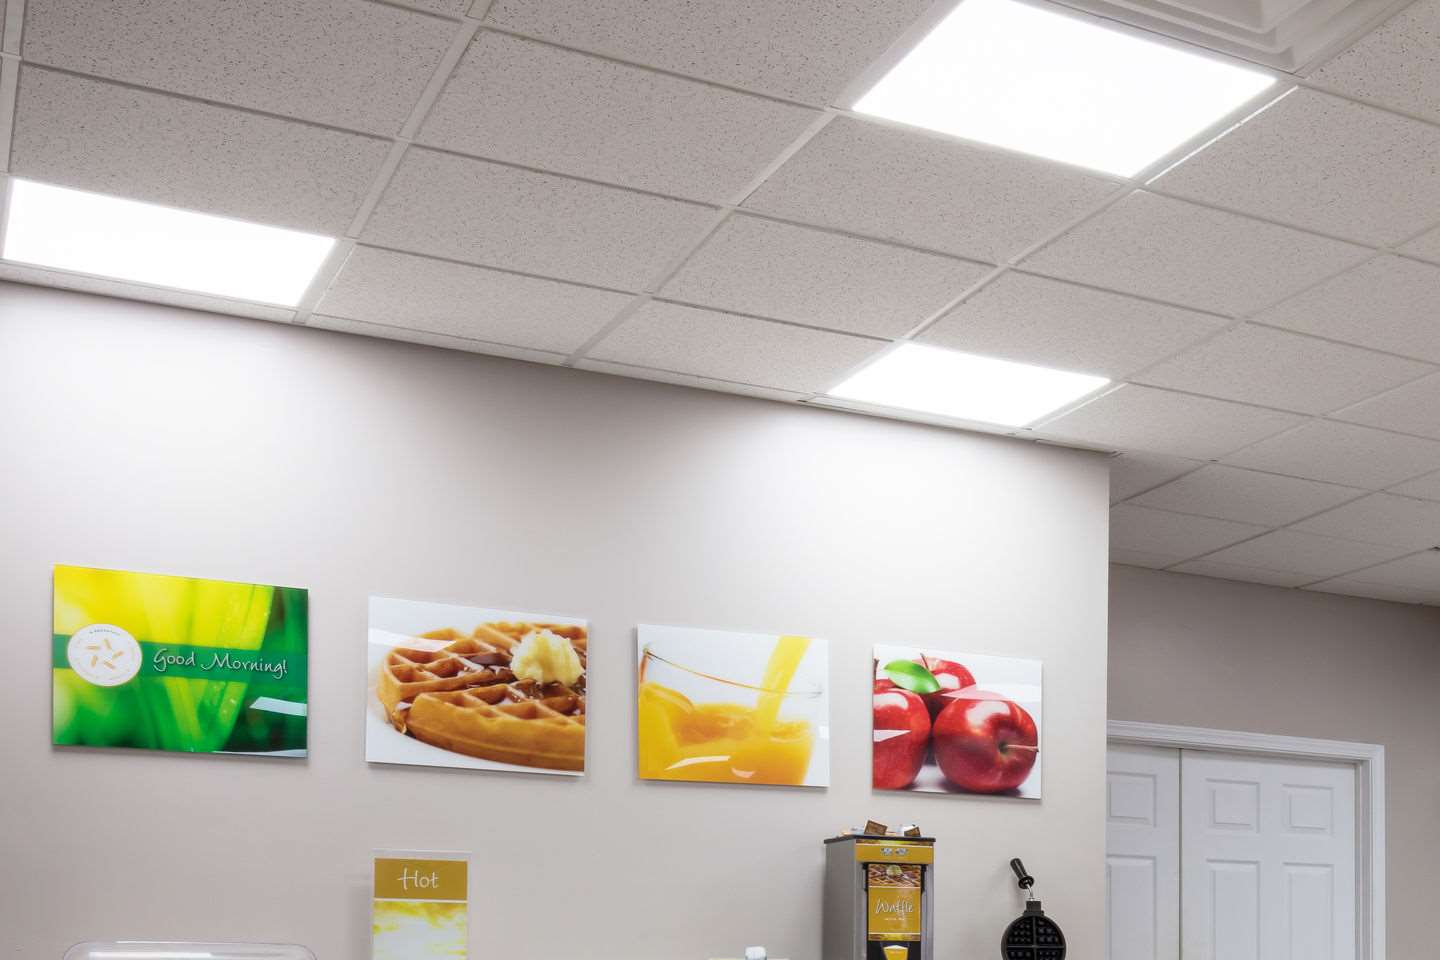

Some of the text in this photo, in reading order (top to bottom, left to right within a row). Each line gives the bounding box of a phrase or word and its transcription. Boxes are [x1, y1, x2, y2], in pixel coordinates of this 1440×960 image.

[153, 648, 287, 679] Good Morning!
[397, 867, 438, 890] Hot
[876, 897, 913, 917] Waffle
